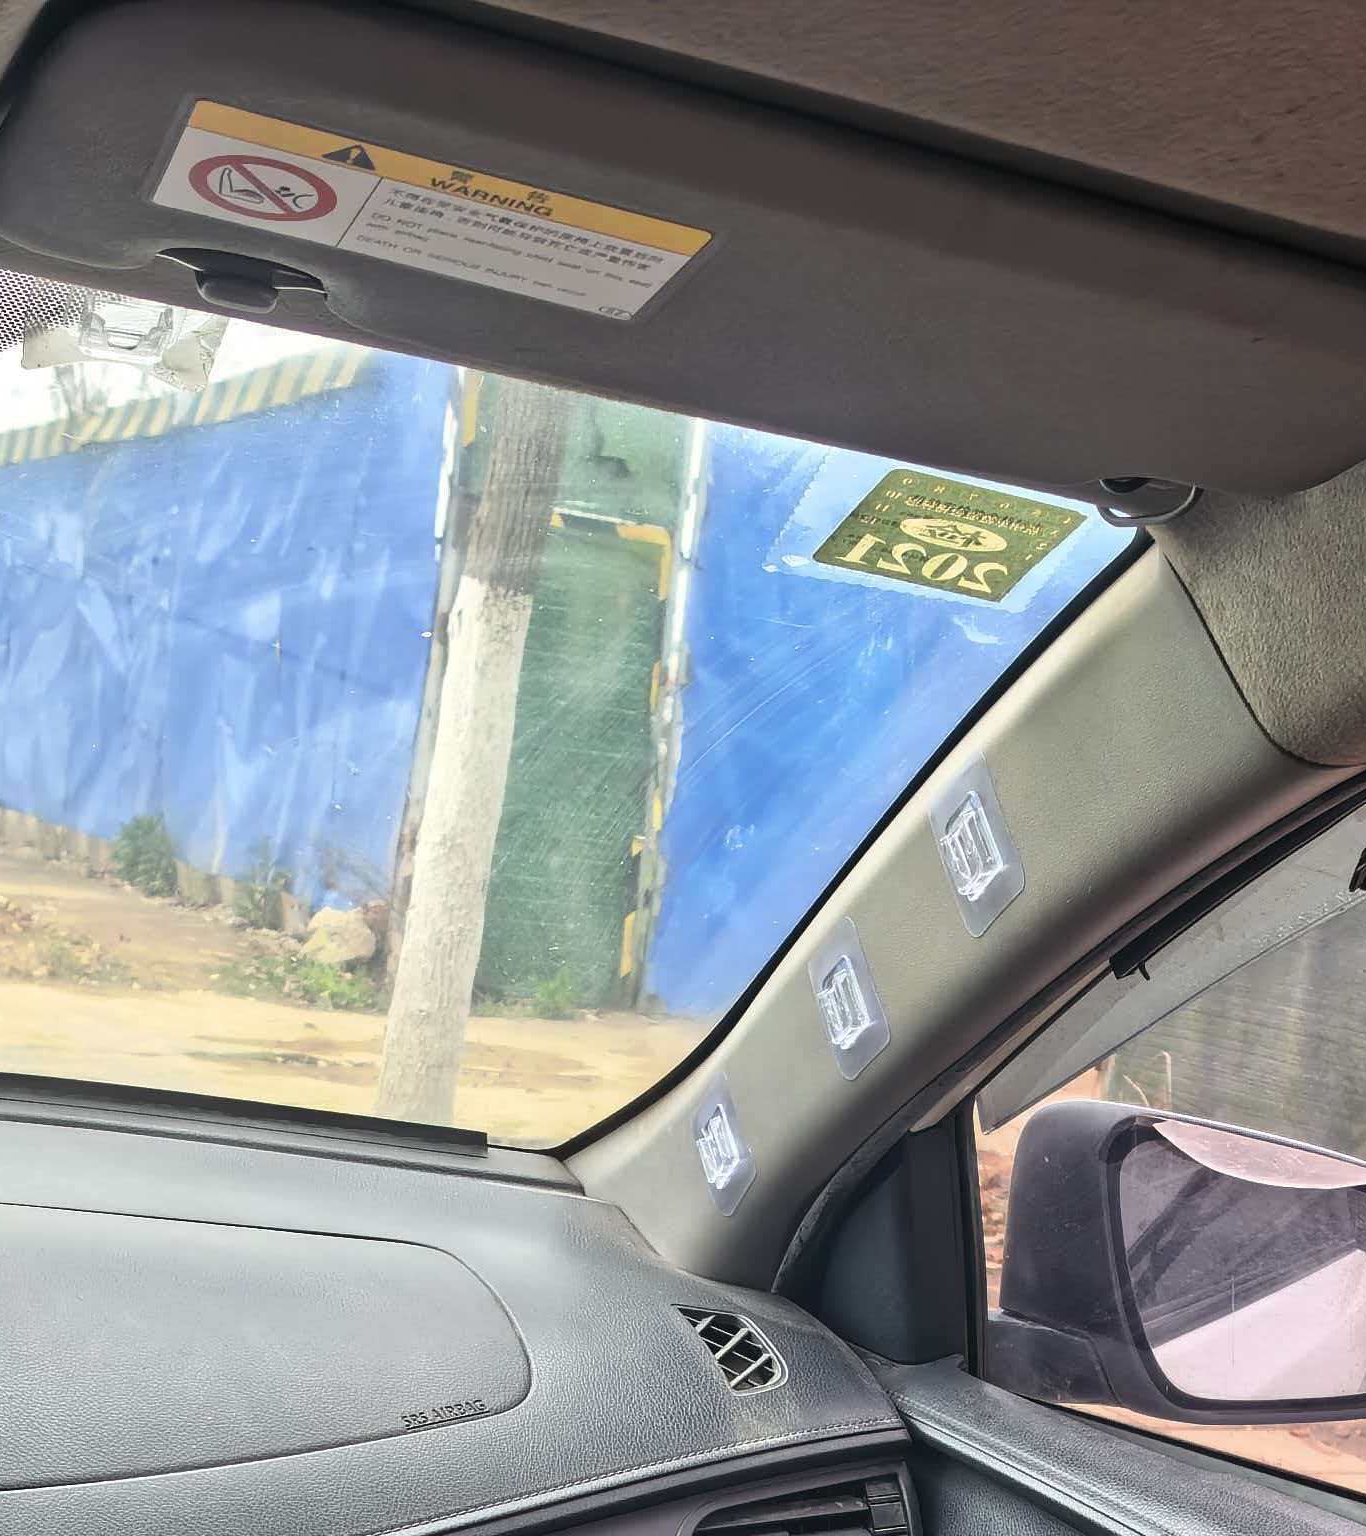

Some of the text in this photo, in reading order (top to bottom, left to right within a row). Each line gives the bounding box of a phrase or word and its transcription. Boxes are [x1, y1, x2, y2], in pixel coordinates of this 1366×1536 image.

[431, 177, 554, 217] WARNING
[396, 219, 423, 230] NOT
[400, 1400, 488, 1428] SRS AIRBAG
